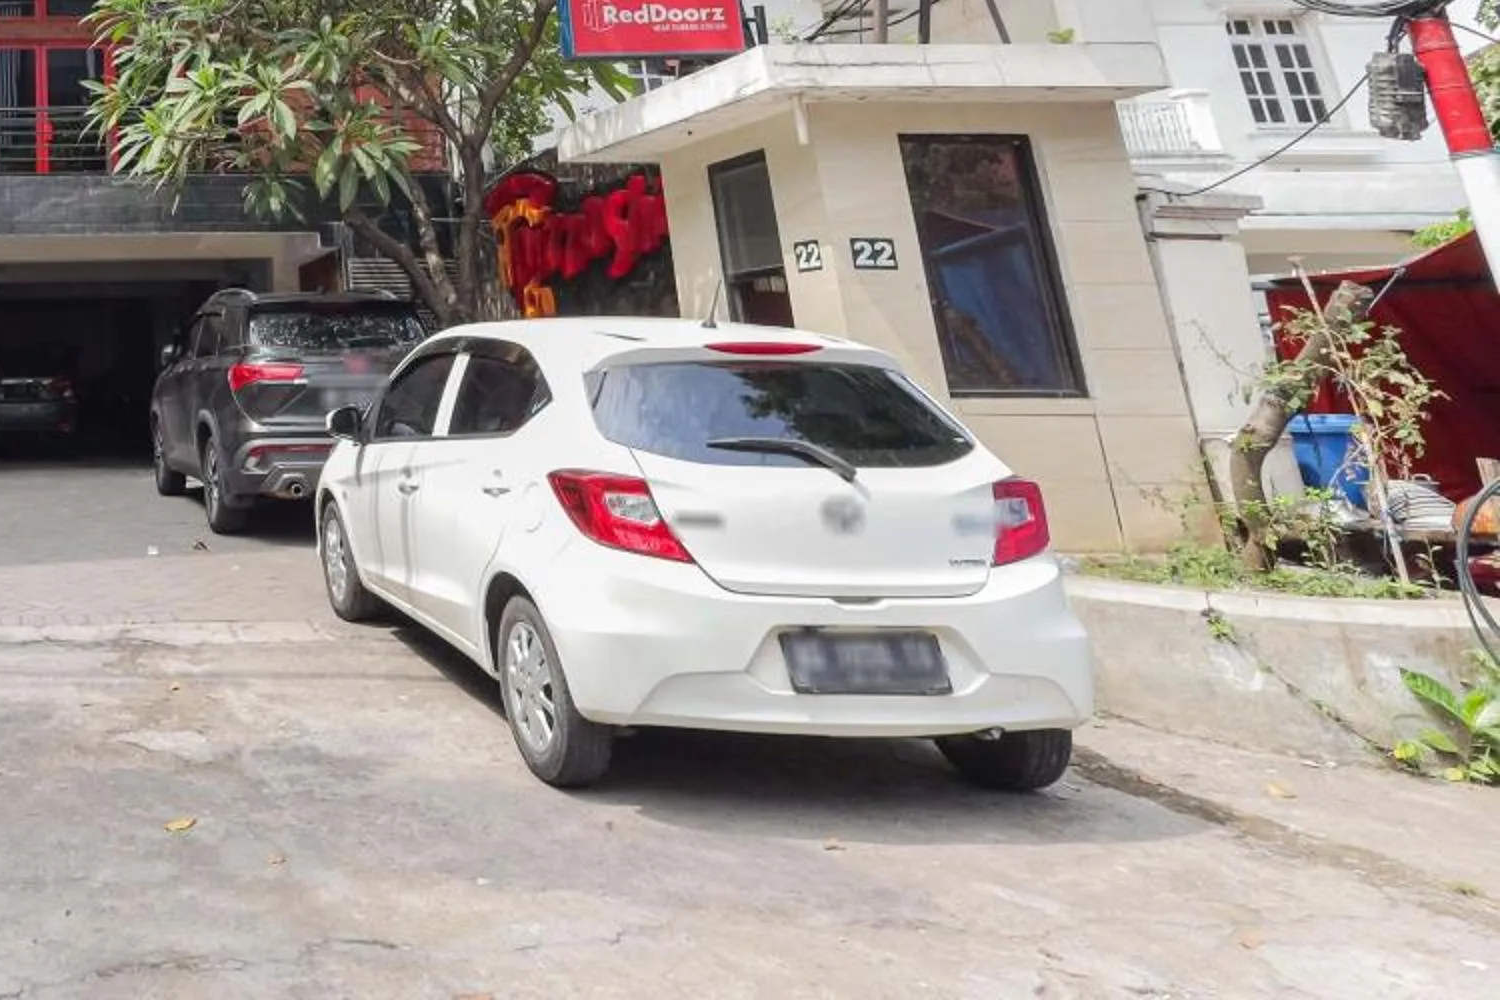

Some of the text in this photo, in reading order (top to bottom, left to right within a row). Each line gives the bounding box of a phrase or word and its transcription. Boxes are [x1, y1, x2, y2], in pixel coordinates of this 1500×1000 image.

[602, 2, 725, 25] RedDoorz
[795, 243, 821, 269] 22
[853, 240, 897, 267] 22
